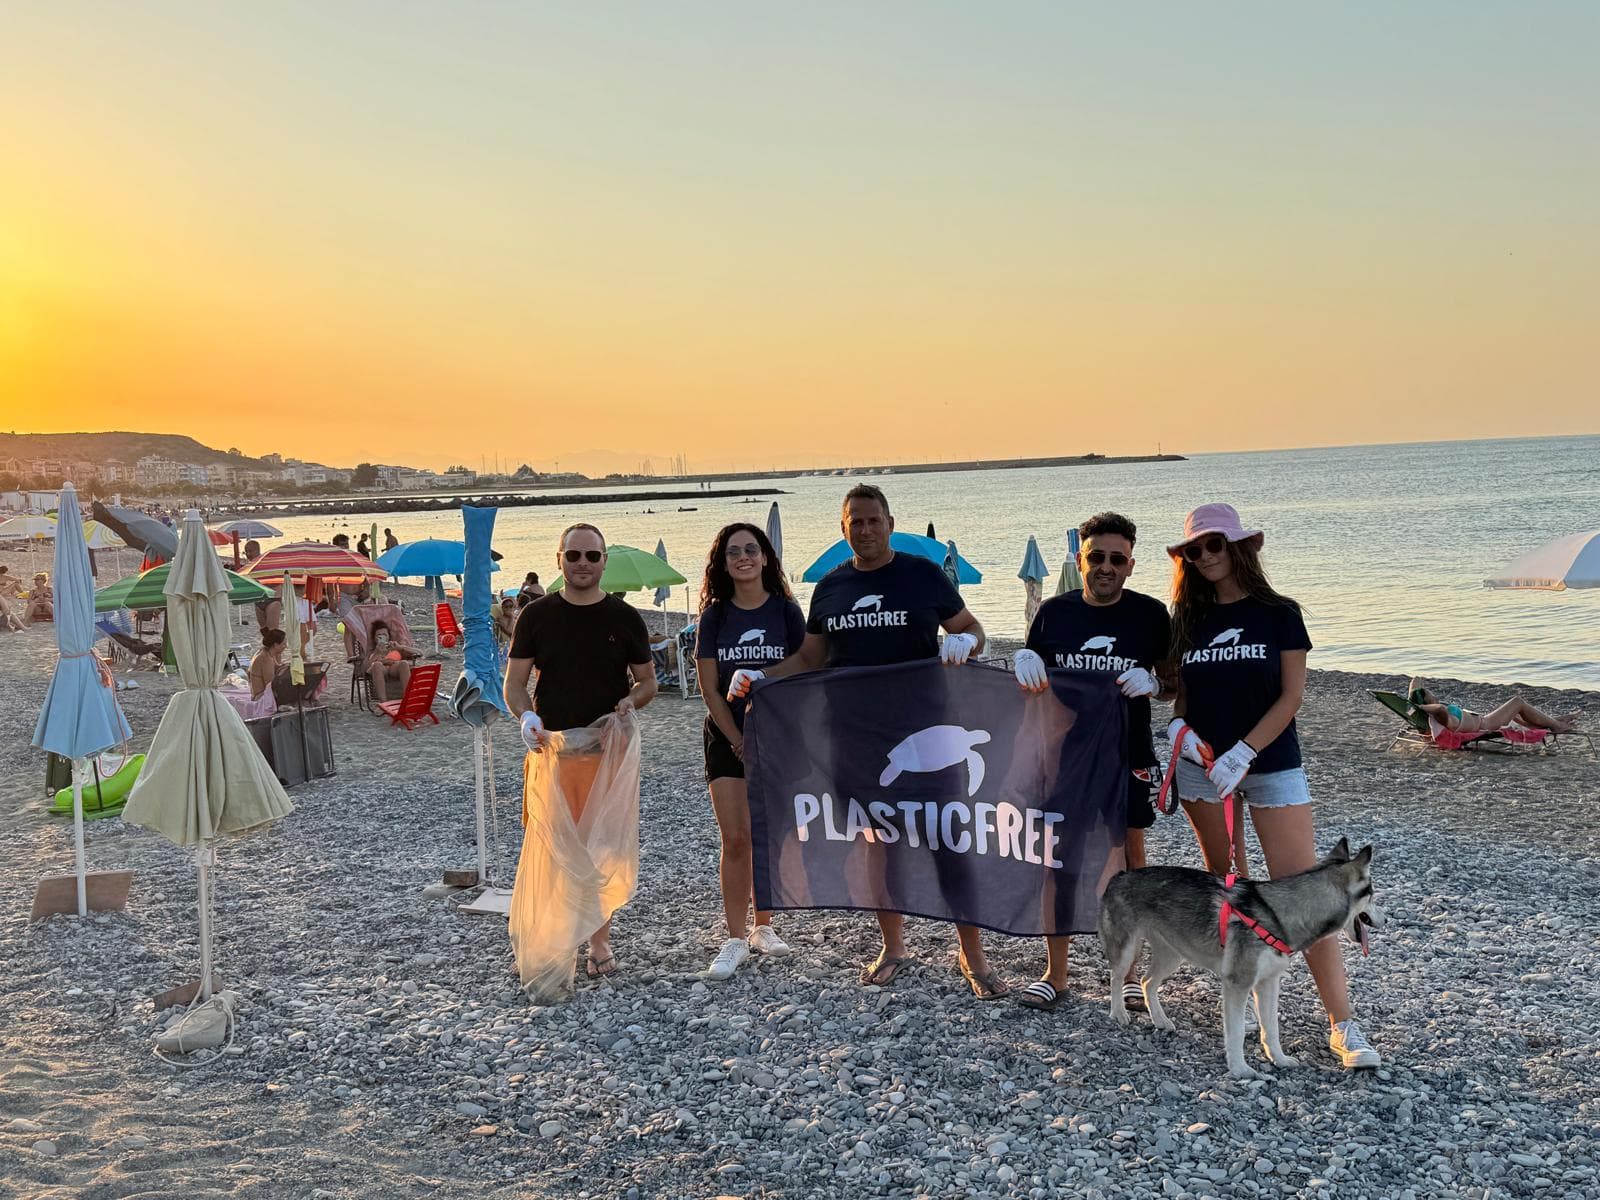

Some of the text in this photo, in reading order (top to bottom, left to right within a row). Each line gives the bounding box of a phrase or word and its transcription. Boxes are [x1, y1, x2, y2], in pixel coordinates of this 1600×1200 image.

[827, 610, 908, 632] PLASTICFREE
[717, 645, 785, 661] PLASTICFREE
[794, 793, 1065, 868] PLASTICFREE
